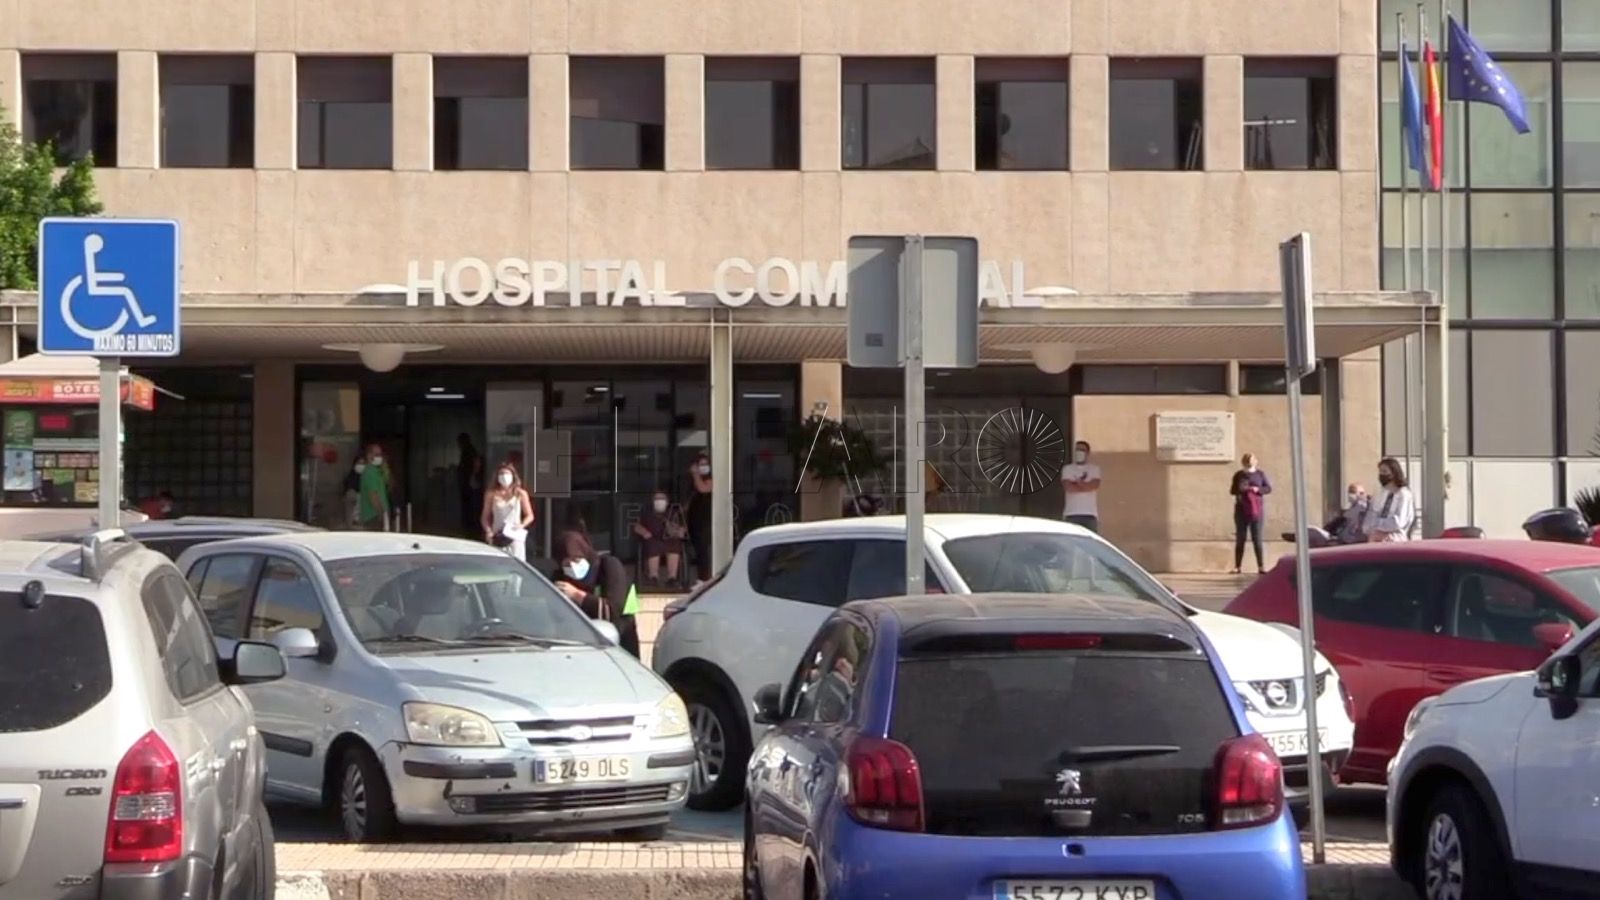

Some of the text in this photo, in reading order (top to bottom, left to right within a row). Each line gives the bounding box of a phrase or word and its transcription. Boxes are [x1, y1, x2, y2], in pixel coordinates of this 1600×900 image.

[406, 257, 1043, 308] HOSPITAL COMAL
[138, 334, 173, 351] MINUTOS
[37, 769, 107, 780] TUCSON
[548, 758, 629, 780] 5249 DLS
